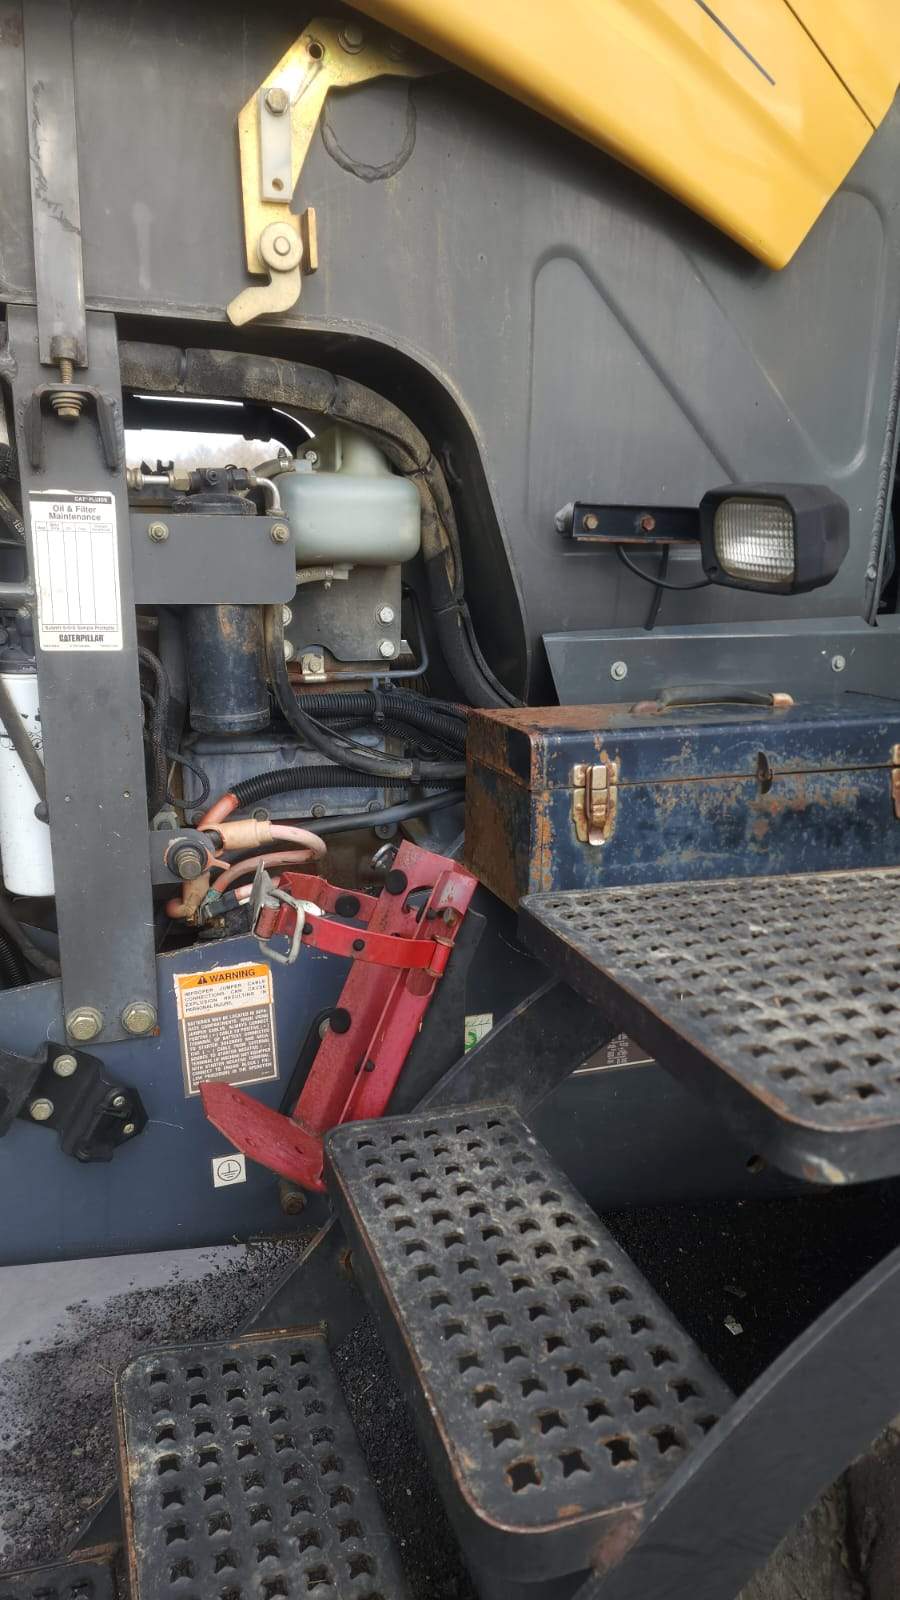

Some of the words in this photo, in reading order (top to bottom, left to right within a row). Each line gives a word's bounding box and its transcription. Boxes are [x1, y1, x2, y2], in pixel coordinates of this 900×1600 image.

[52, 504, 64, 512] Oil
[48, 512, 102, 521] Maintenance
[58, 634, 104, 642] CATERPILLAR
[209, 969, 255, 982] WARNING
